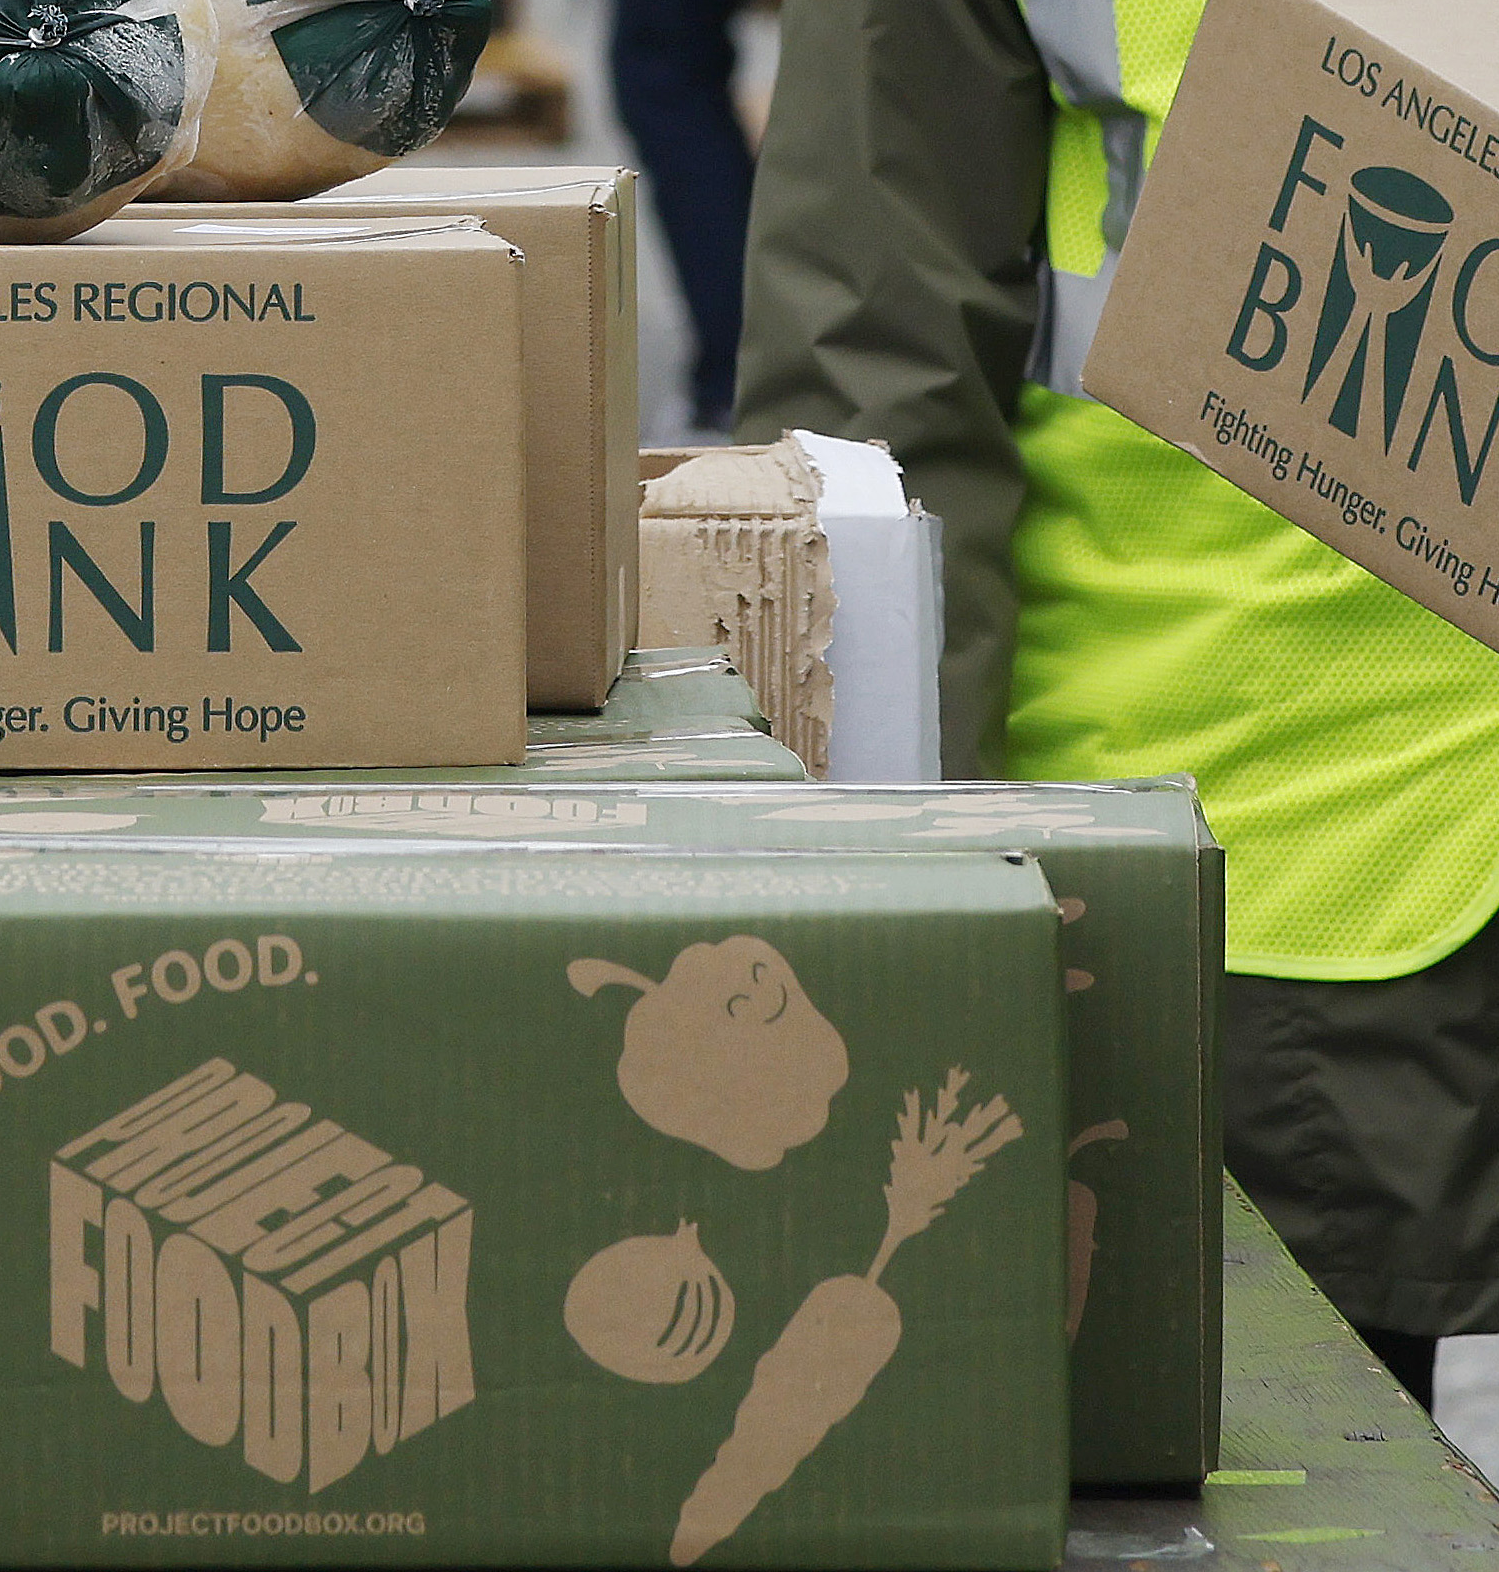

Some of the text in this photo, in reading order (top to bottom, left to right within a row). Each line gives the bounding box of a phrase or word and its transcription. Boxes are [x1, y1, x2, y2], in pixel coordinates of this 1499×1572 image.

[1321, 36, 1382, 97] LOS
[73, 281, 315, 323] REGIONAL
[1200, 390, 1294, 481] Fighting
[1296, 450, 1387, 534] Hunger.
[1396, 515, 1476, 597] Giving
[64, 696, 189, 744] Giving
[203, 697, 305, 745] Hope
[112, 934, 319, 1020] FOOD.
[52, 1056, 469, 1295] PROJECT
[102, 1511, 425, 1535] PROJECTFOODBOX.ORG
